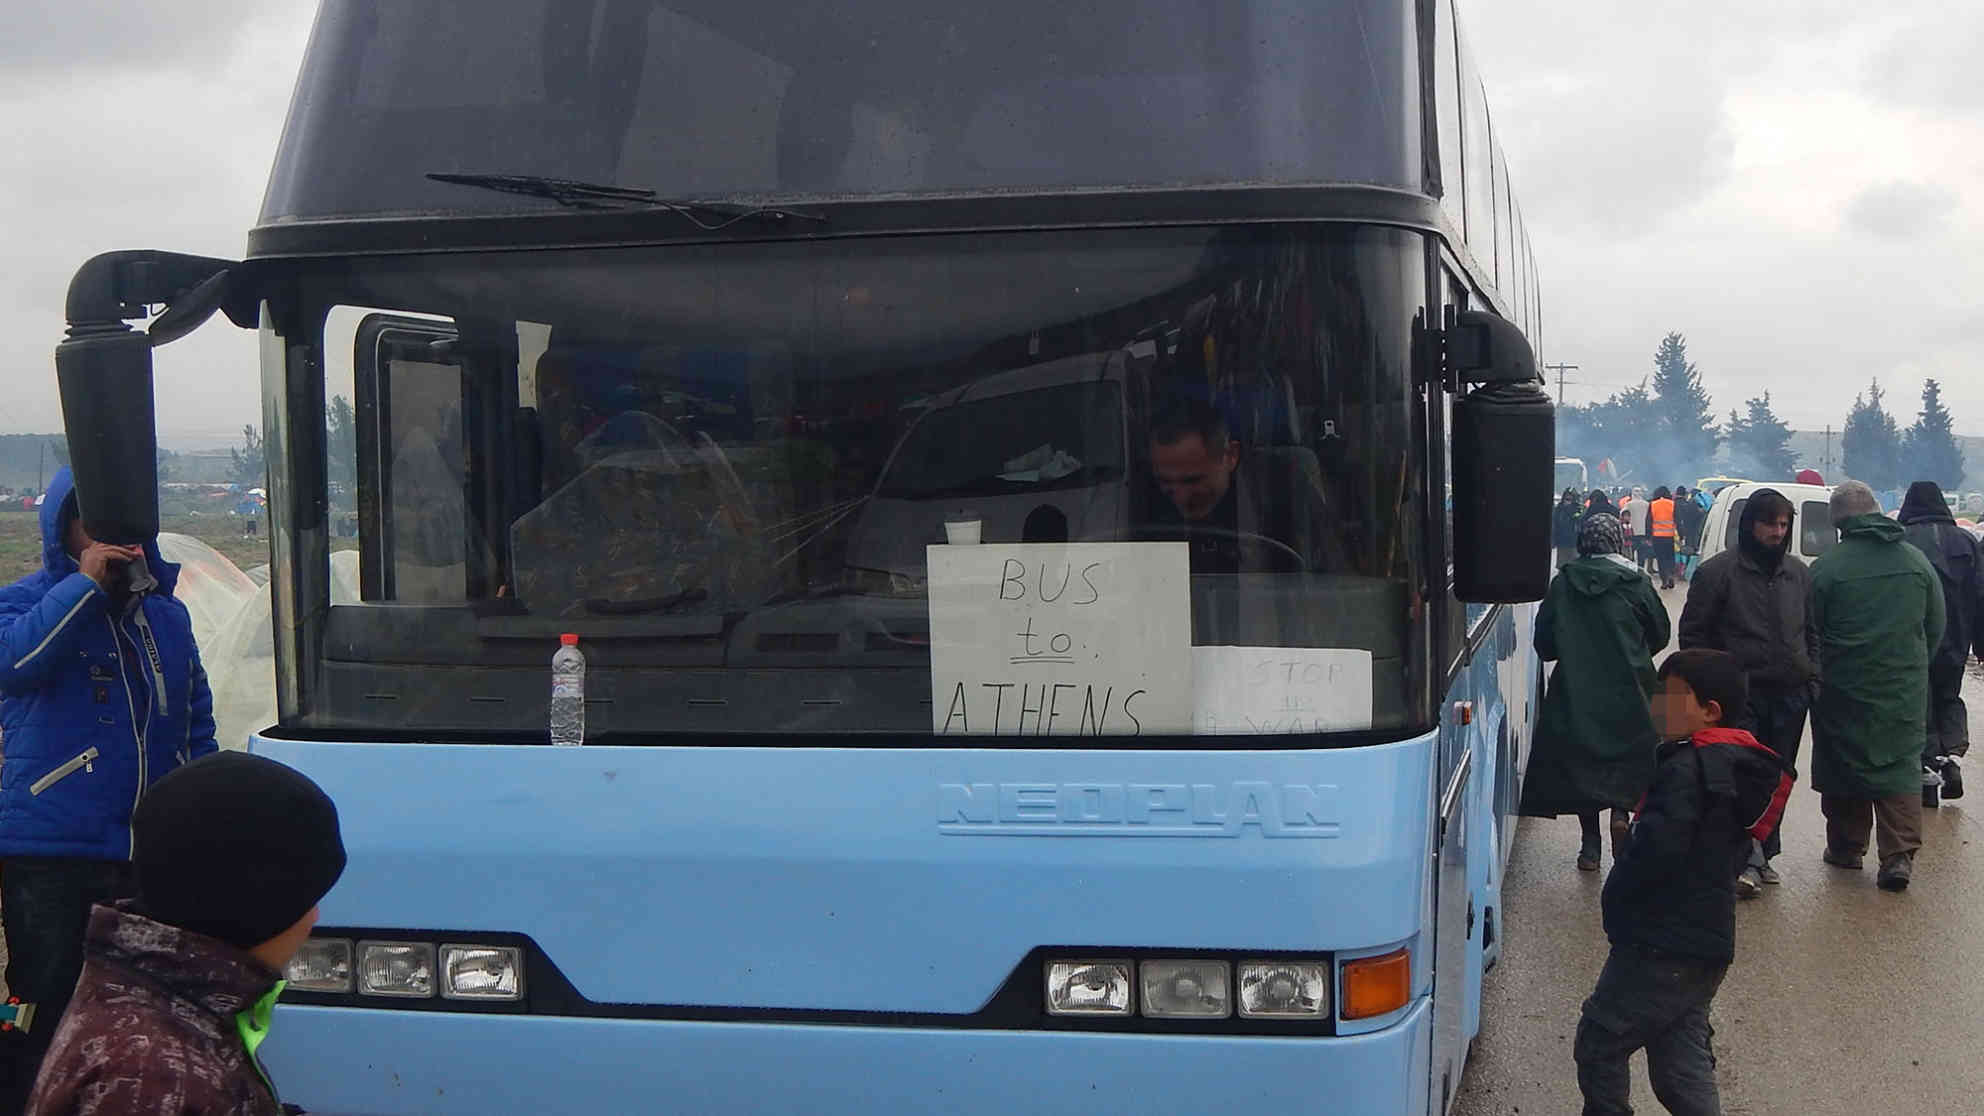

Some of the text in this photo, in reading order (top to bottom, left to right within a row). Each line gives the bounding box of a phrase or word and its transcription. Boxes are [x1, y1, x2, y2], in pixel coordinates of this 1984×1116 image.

[1000, 558, 1101, 605] BUS
[943, 681, 1147, 736] ATHENS
[938, 781, 1341, 838] NEOPLAN
